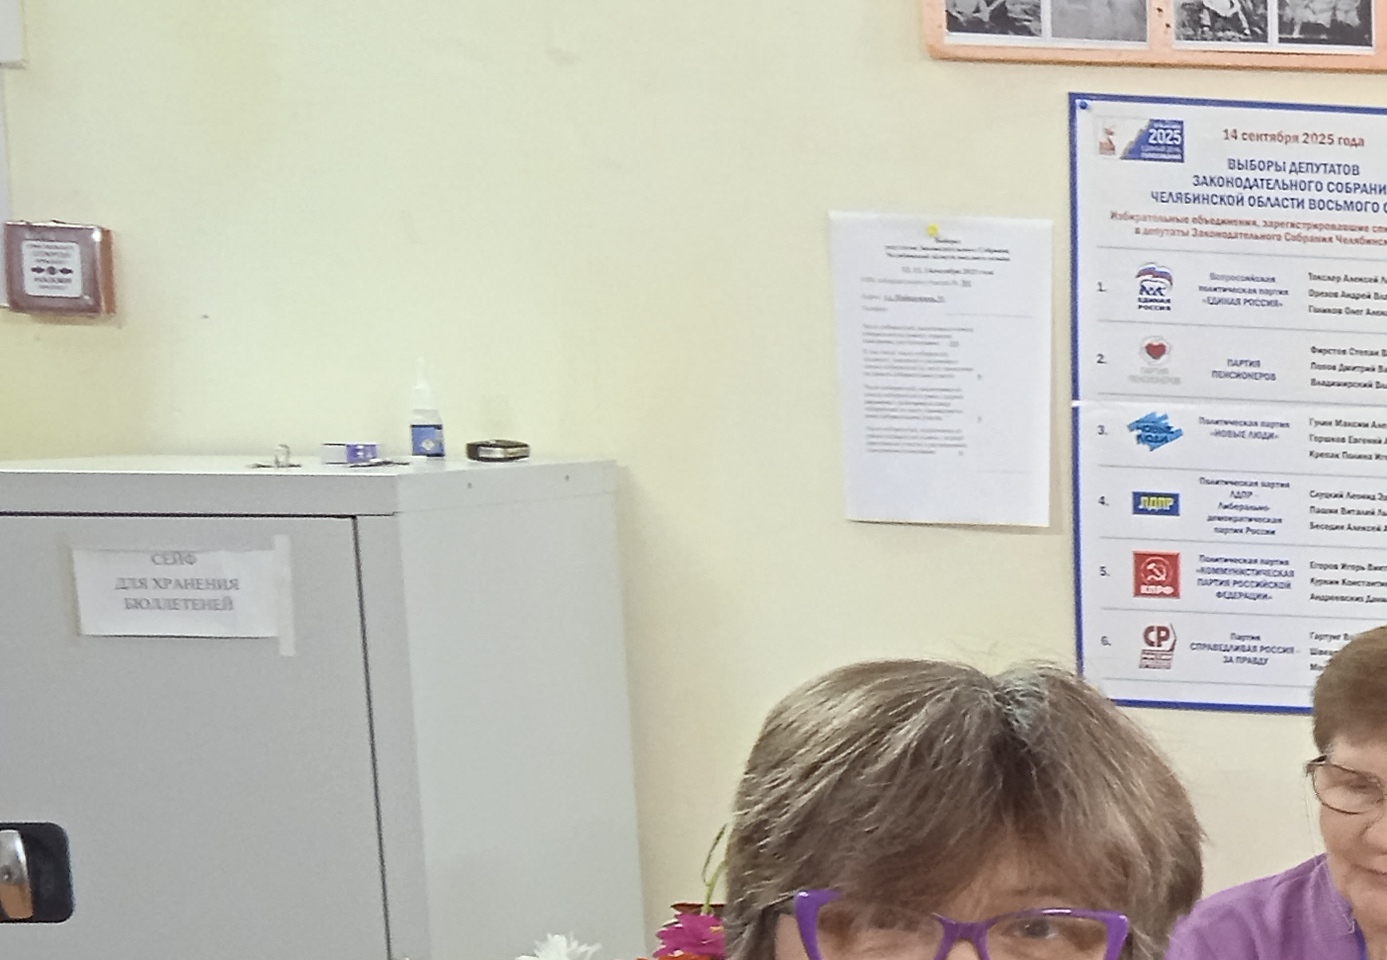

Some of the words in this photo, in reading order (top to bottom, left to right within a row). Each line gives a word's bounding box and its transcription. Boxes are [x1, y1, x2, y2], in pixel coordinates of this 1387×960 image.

[1149, 129, 1181, 145] 2025
[1223, 128, 1238, 142] 14
[1241, 130, 1298, 145] сентября
[1302, 132, 1335, 145] 2025
[1338, 135, 1365, 148] года
[1228, 158, 1286, 173] ВЫБОРЫ
[1289, 161, 1360, 176] ДЕПУТАТОВ
[1192, 174, 1323, 193] ЗАКОНОДАТЕЛЬНОГО
[1151, 190, 1244, 207] ЧЕЛЯБИНСКОЙ
[1249, 195, 1305, 209] ОБЛАСТИ
[1308, 199, 1380, 214] ВОСЬМОГО
[1110, 211, 1189, 225] Избирательные
[1192, 215, 1259, 228] объединения,
[1262, 217, 1369, 233] зарегистрировавшие
[1143, 228, 1189, 239] депутаты
[1192, 228, 1282, 243] Законодательного
[1285, 232, 1333, 245] Собрания
[151, 551, 198, 567] СЕЙФ
[114, 577, 149, 592] ДЛЯ
[152, 577, 240, 592] ХРАНЕНИЯ
[123, 595, 235, 612] БЮЛЛЕТЕНЕЙ
[1143, 625, 1170, 647] СР
